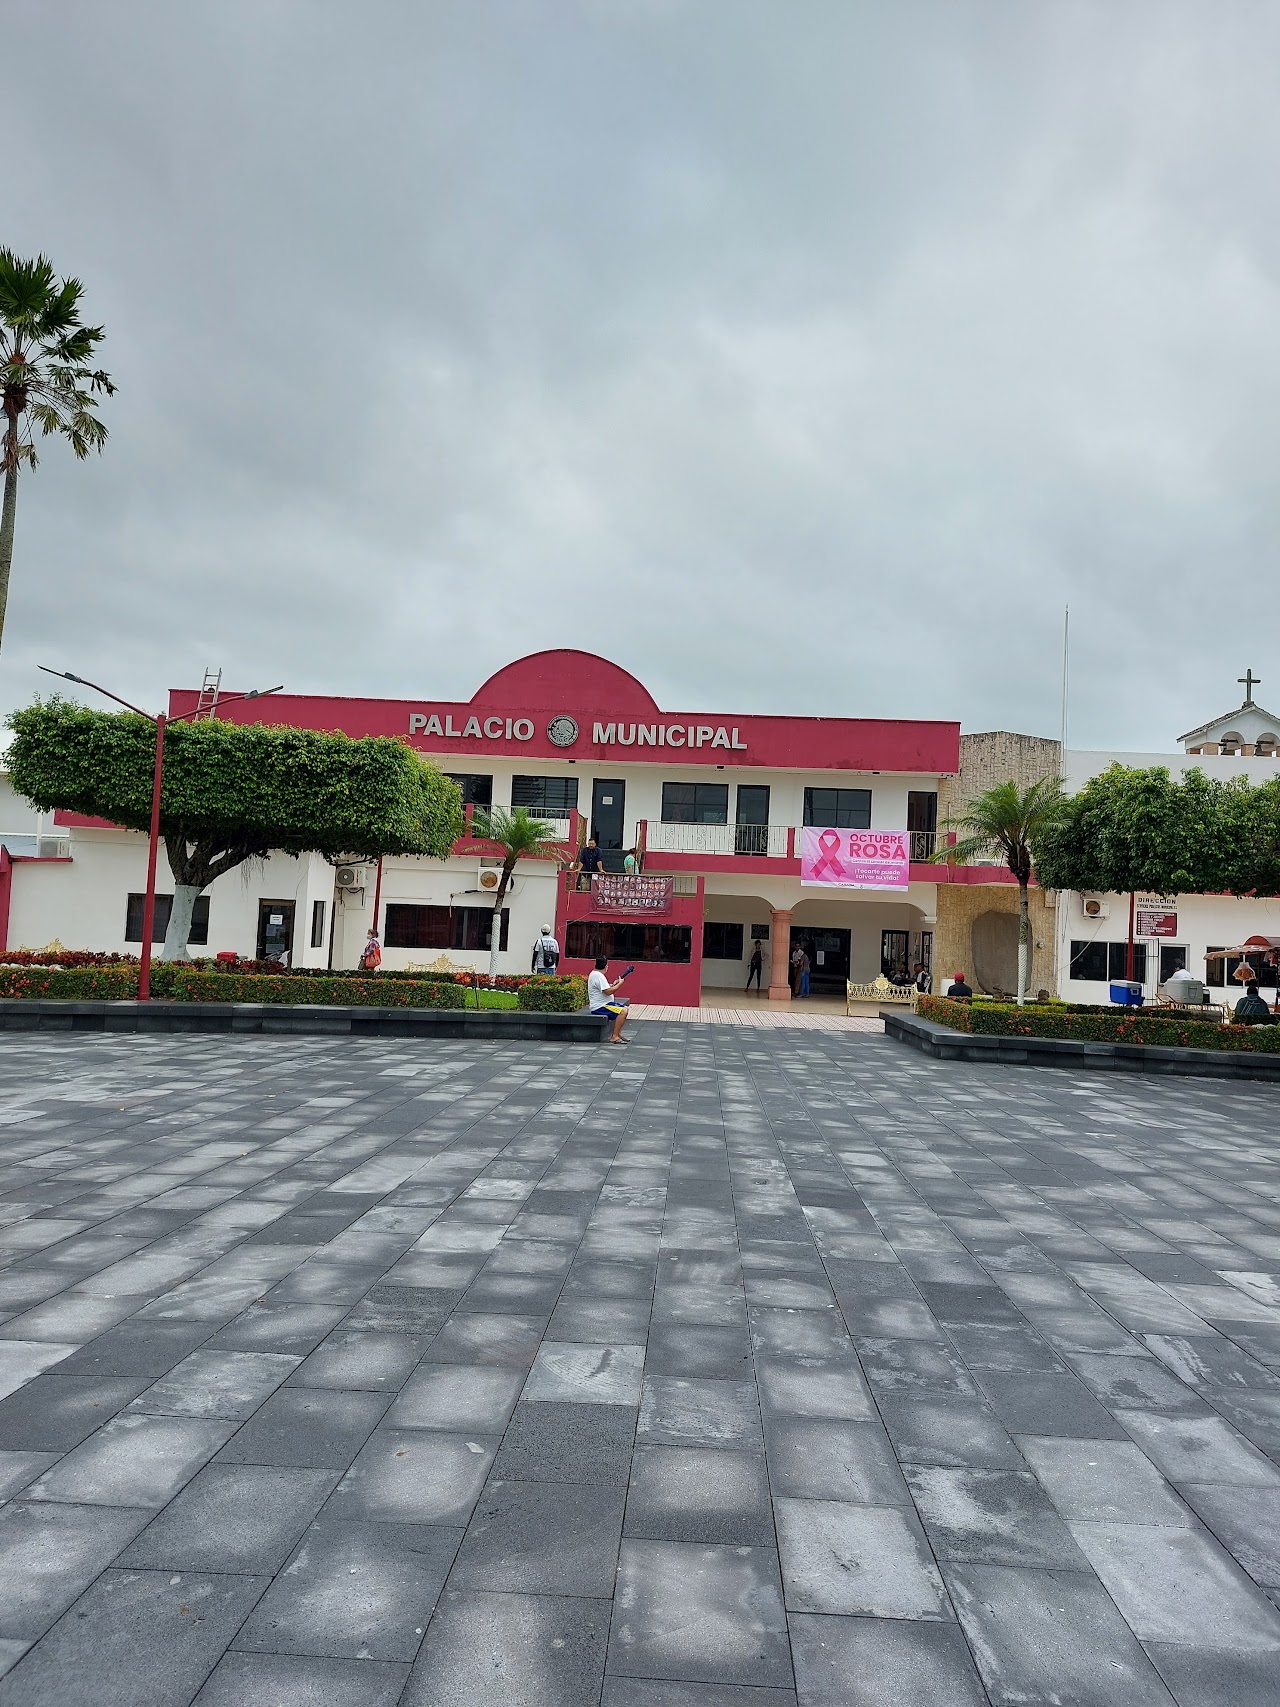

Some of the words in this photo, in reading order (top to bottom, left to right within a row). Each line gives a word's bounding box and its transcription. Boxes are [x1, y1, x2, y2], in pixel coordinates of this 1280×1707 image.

[409, 713, 535, 741] PALACIO
[592, 722, 748, 750] MUNICIPAL
[850, 834, 903, 844] OCTUBRE
[850, 843, 906, 859] ROSA
